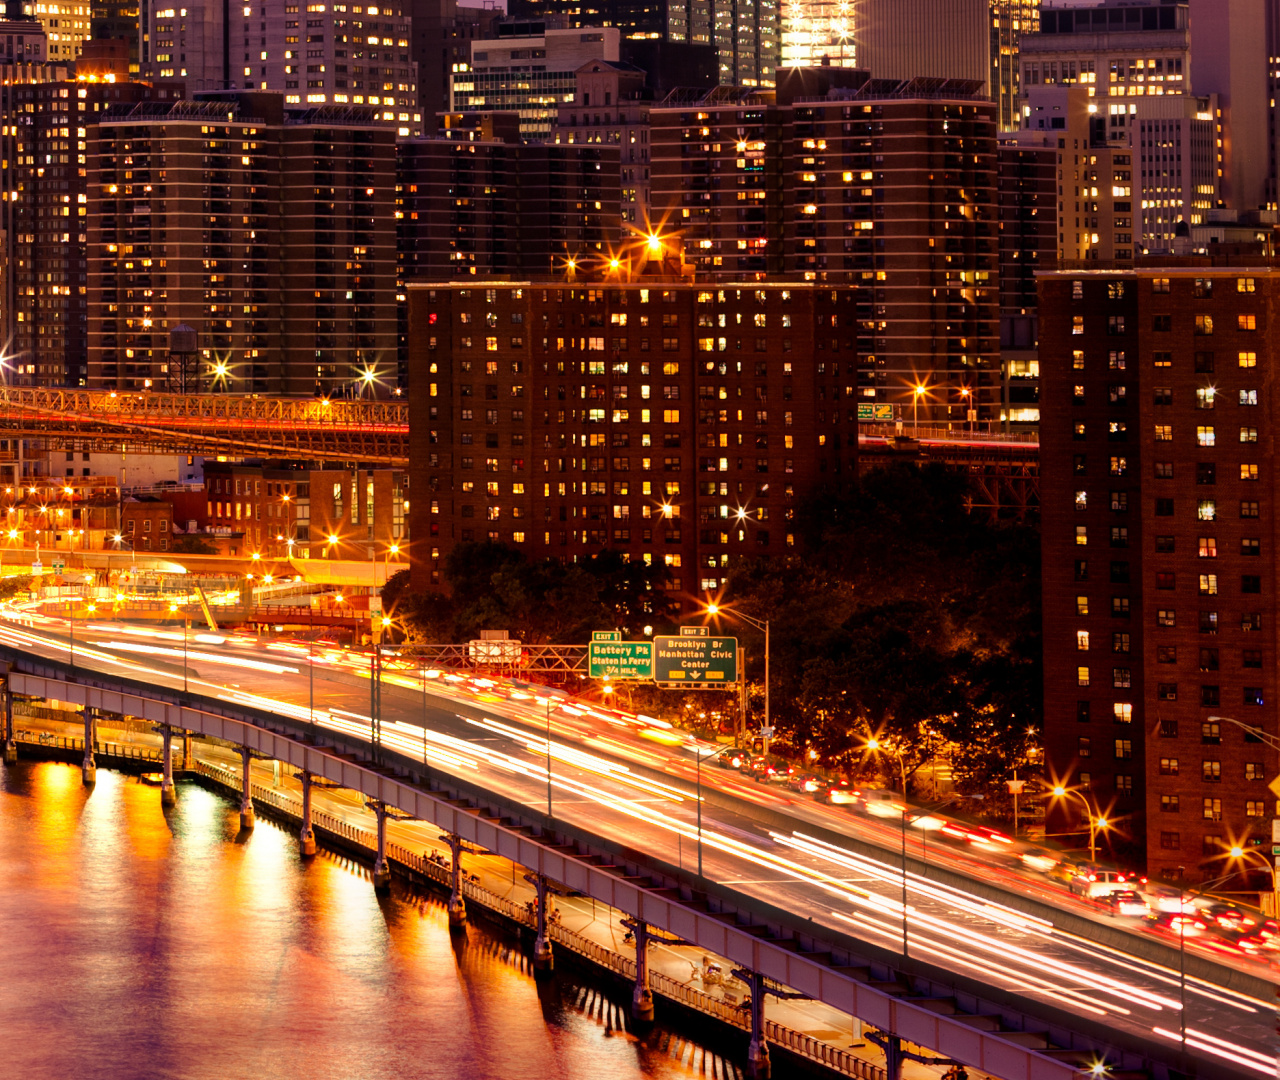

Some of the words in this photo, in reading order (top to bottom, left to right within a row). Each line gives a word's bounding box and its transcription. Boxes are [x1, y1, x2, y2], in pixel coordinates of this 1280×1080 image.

[668, 640, 706, 650] Brooklyn
[712, 640, 723, 648] Br
[593, 646, 631, 656] Battery
[636, 646, 649, 655] Pk
[658, 650, 705, 658] Manhattan
[710, 650, 732, 658] Civic
[592, 657, 619, 665] Staten
[629, 658, 651, 667] Ferry
[681, 660, 710, 668] Center
[606, 666, 618, 674] 3/4
